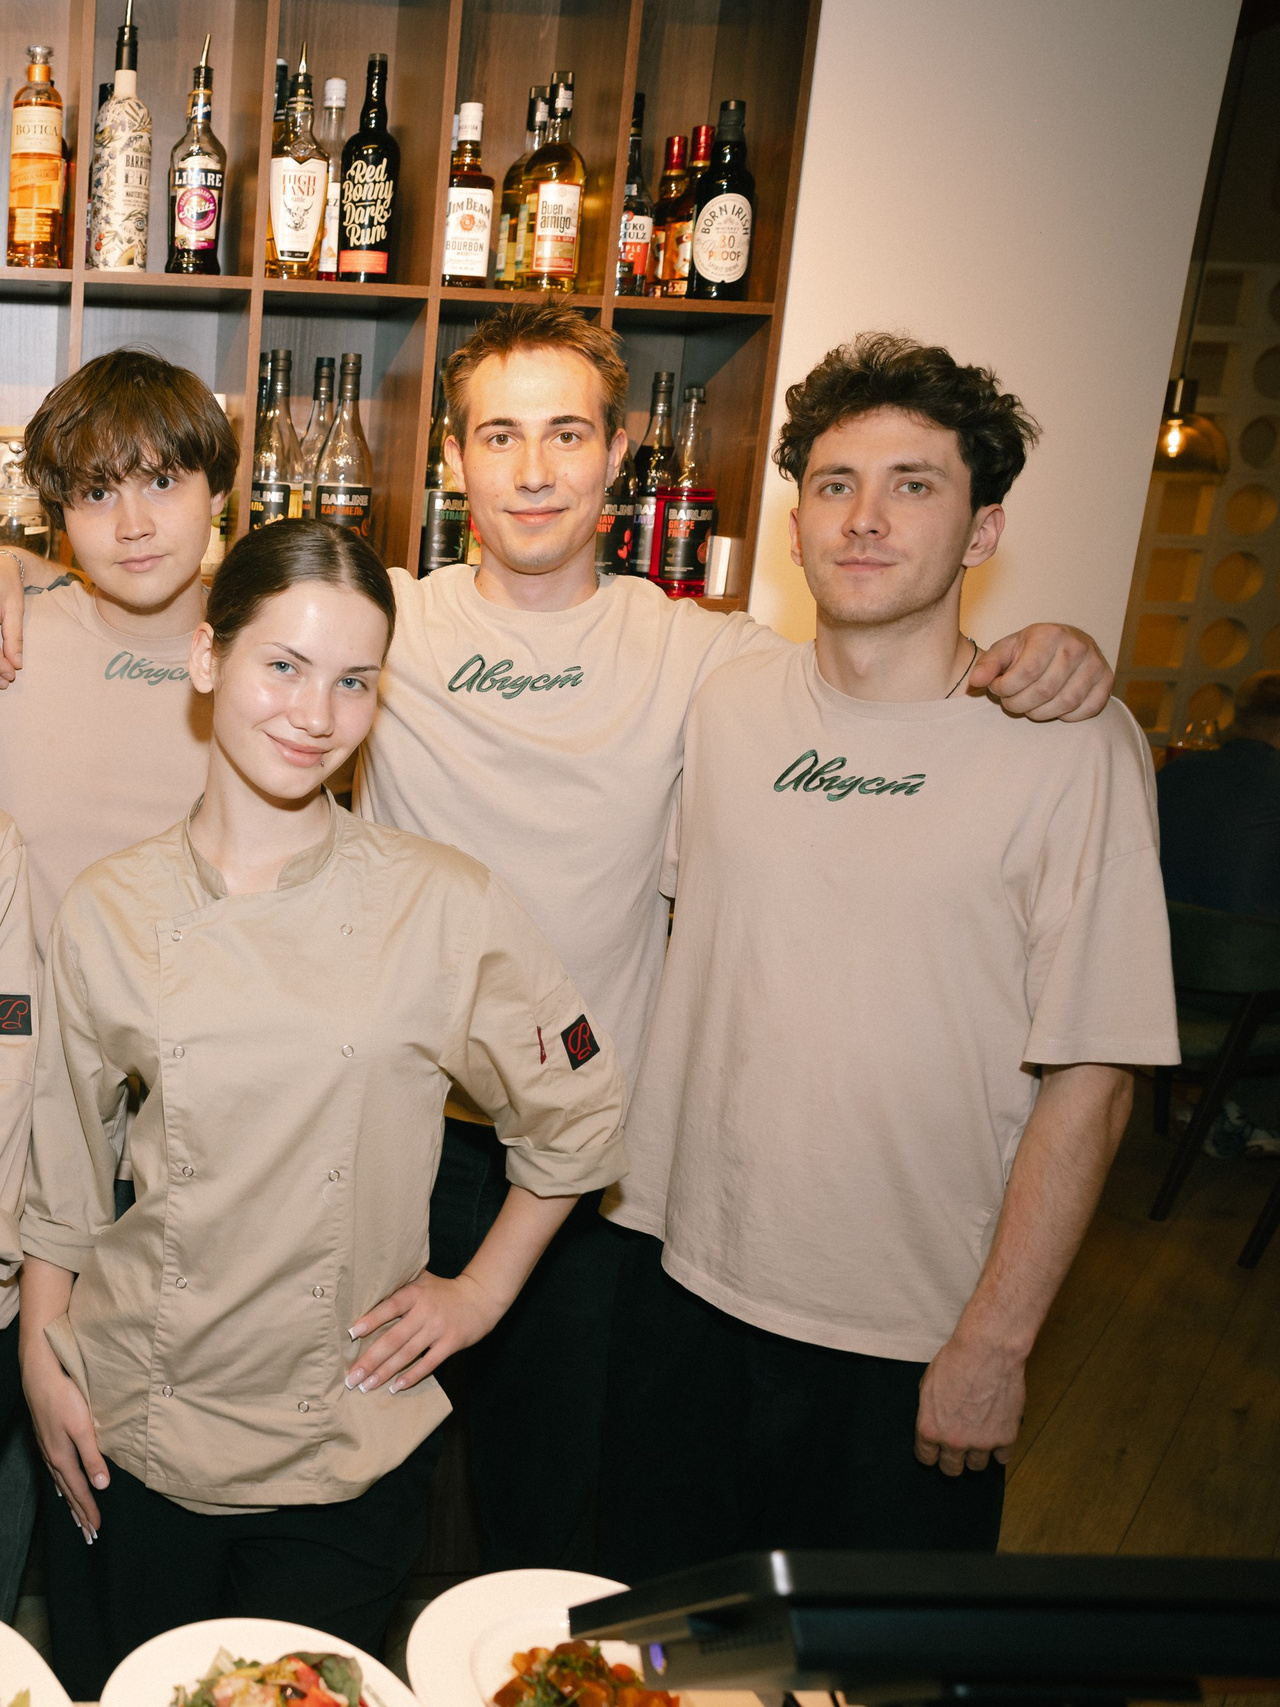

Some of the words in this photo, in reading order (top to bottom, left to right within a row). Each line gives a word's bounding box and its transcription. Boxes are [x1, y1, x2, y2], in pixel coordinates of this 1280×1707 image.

[16, 124, 58, 137] BOTICA
[346, 158, 387, 184] Red
[283, 174, 316, 187] HIGH
[342, 180, 394, 209] Bonny
[343, 202, 391, 227] Dark
[466, 197, 491, 219] BEAM
[541, 201, 564, 215] Buen
[540, 215, 572, 233] amigo
[701, 204, 728, 234] BORN
[731, 204, 749, 235] IRISH
[346, 224, 387, 247] Rum
[446, 241, 484, 252] BOURBON
[709, 250, 741, 261] POOF
[321, 493, 369, 506] BARLINE
[321, 505, 363, 516] КАРАМЕЛЬ
[668, 520, 695, 530] GRAPE
[448, 654, 584, 699] Август
[773, 749, 926, 802] Август
